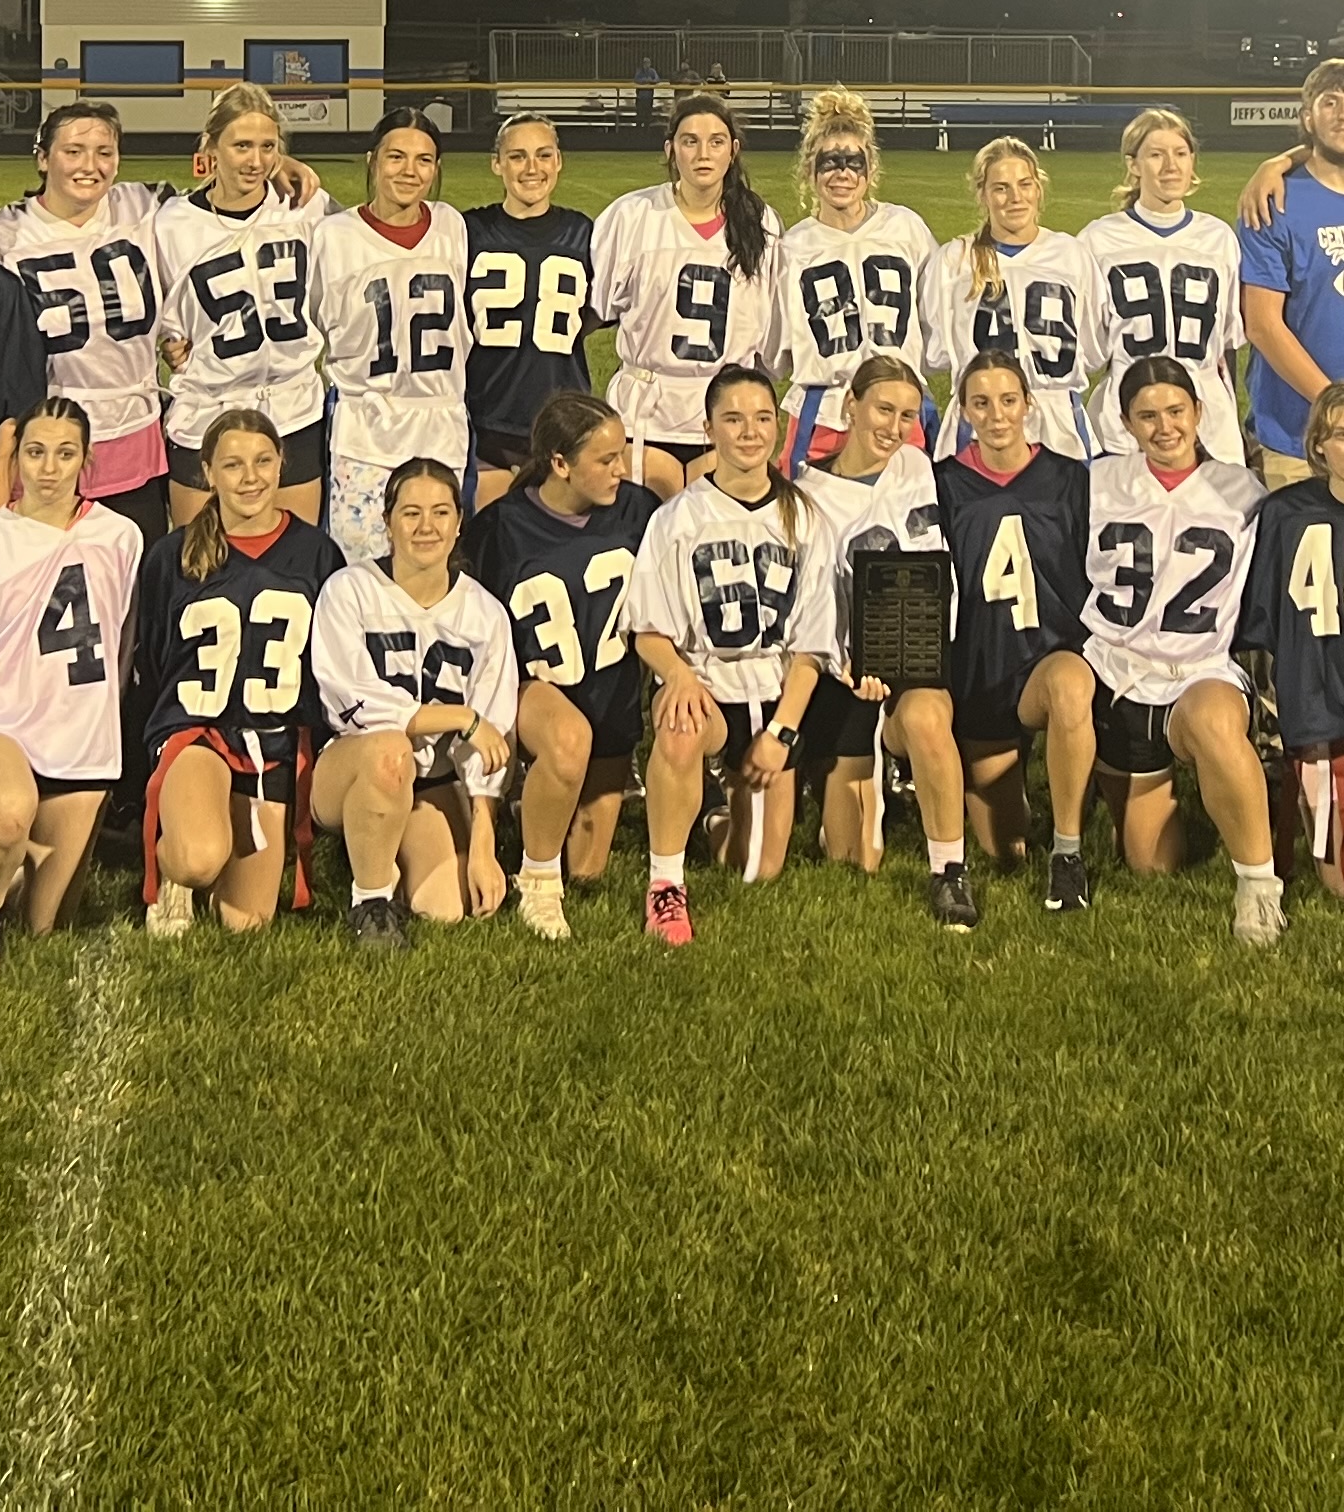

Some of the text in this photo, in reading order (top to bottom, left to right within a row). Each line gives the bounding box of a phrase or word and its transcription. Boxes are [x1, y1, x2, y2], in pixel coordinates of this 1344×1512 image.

[1233, 107, 1265, 120] JEFF'S
[17, 239, 157, 354] 50
[190, 239, 307, 359] 53
[364, 274, 455, 376] 12
[470, 252, 587, 354] 28
[671, 264, 729, 362] 9
[801, 255, 911, 357] 89
[973, 280, 1077, 378] 49
[1108, 262, 1219, 360] 98
[37, 563, 106, 686] 4
[509, 547, 627, 686] 32
[982, 515, 1039, 631] 4
[1095, 522, 1234, 633] 32
[177, 589, 312, 717] 33
